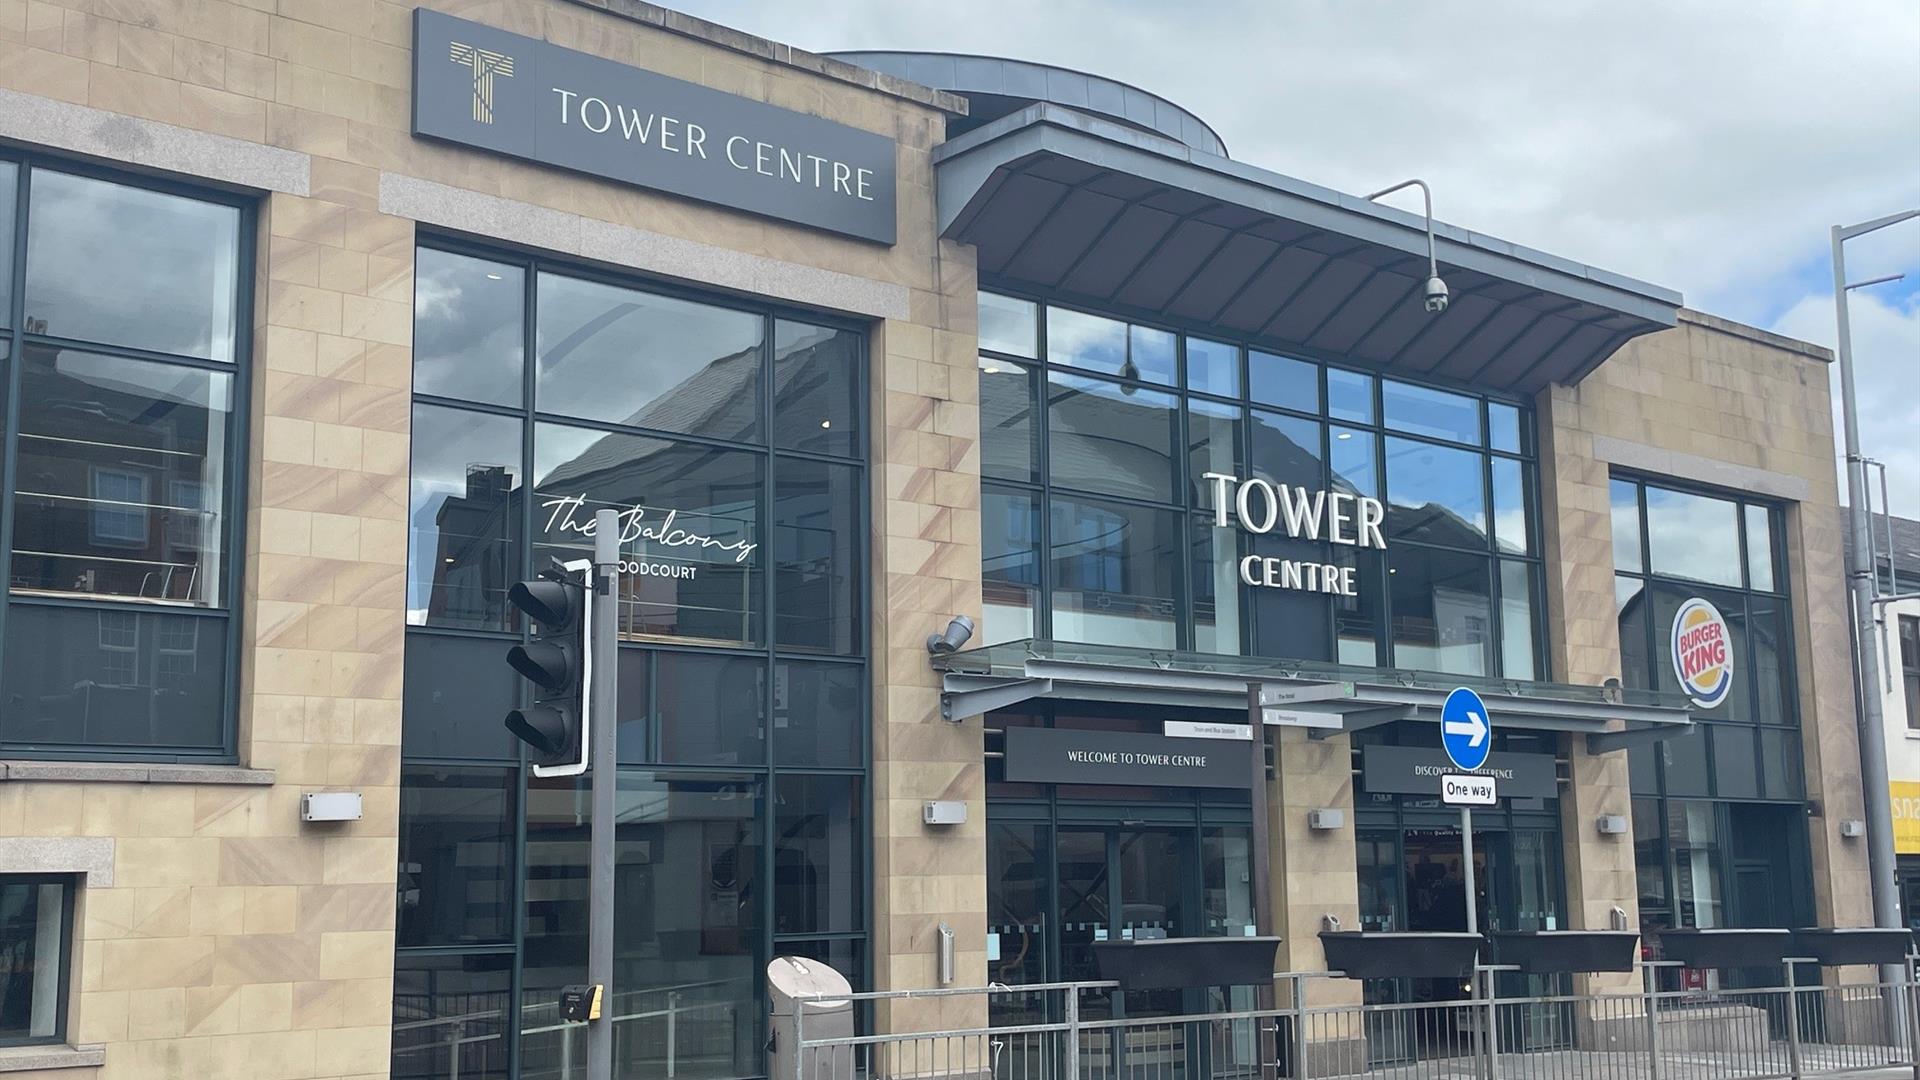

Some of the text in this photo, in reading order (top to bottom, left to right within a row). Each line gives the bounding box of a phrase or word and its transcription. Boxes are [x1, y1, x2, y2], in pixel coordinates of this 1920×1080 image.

[552, 87, 874, 201] TOWER CENTRE
[541, 492, 758, 563] The Balcony
[1202, 471, 1387, 596] TOWER CENTRE
[617, 560, 697, 580] OODCOURT
[1679, 622, 1723, 656] BURGER
[1682, 639, 1726, 681] KING
[1067, 750, 1207, 768] WELCOME TO TOWER CENTRE
[1446, 781, 1492, 800] One way
